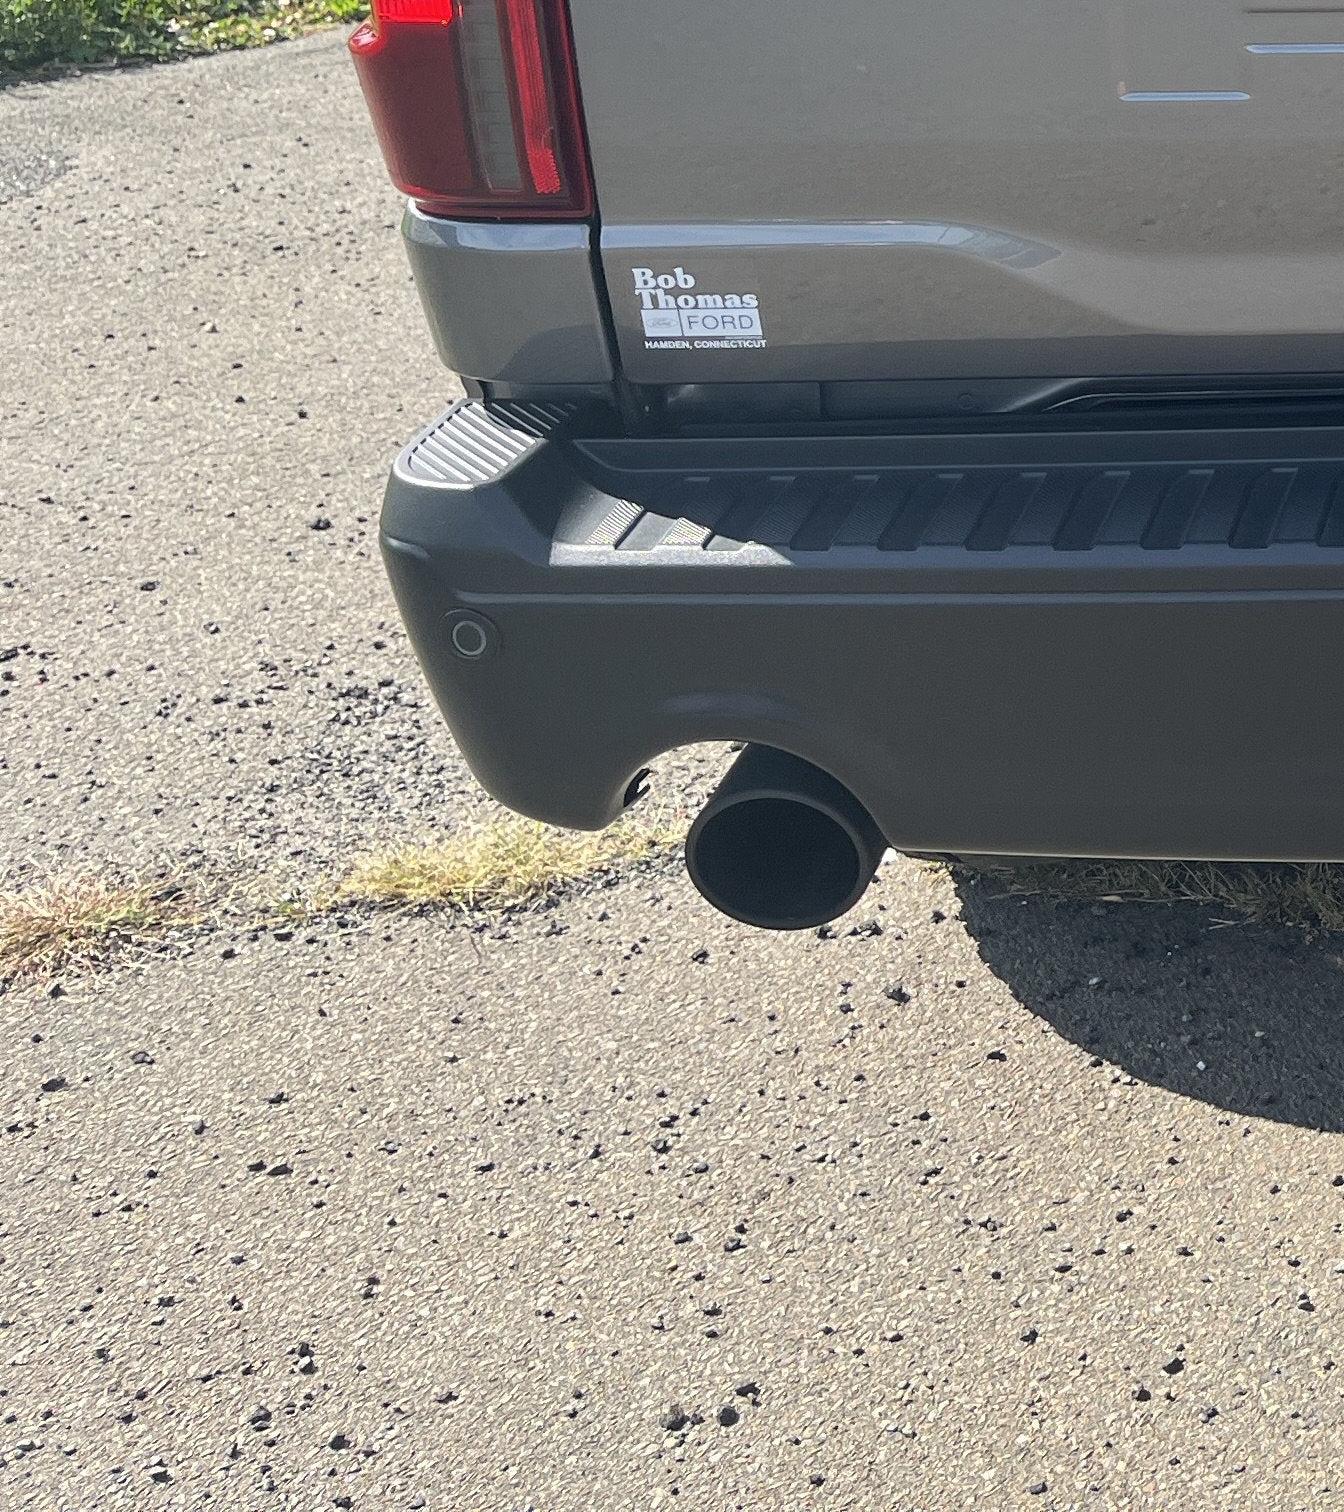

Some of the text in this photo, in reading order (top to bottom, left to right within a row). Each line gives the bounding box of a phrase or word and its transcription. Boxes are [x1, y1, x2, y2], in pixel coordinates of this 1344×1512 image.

[631, 267, 696, 289] Bob
[634, 288, 759, 310] Thomas
[687, 315, 754, 330] FORD
[644, 339, 767, 350] HAMDEN, CONNECTICUT
